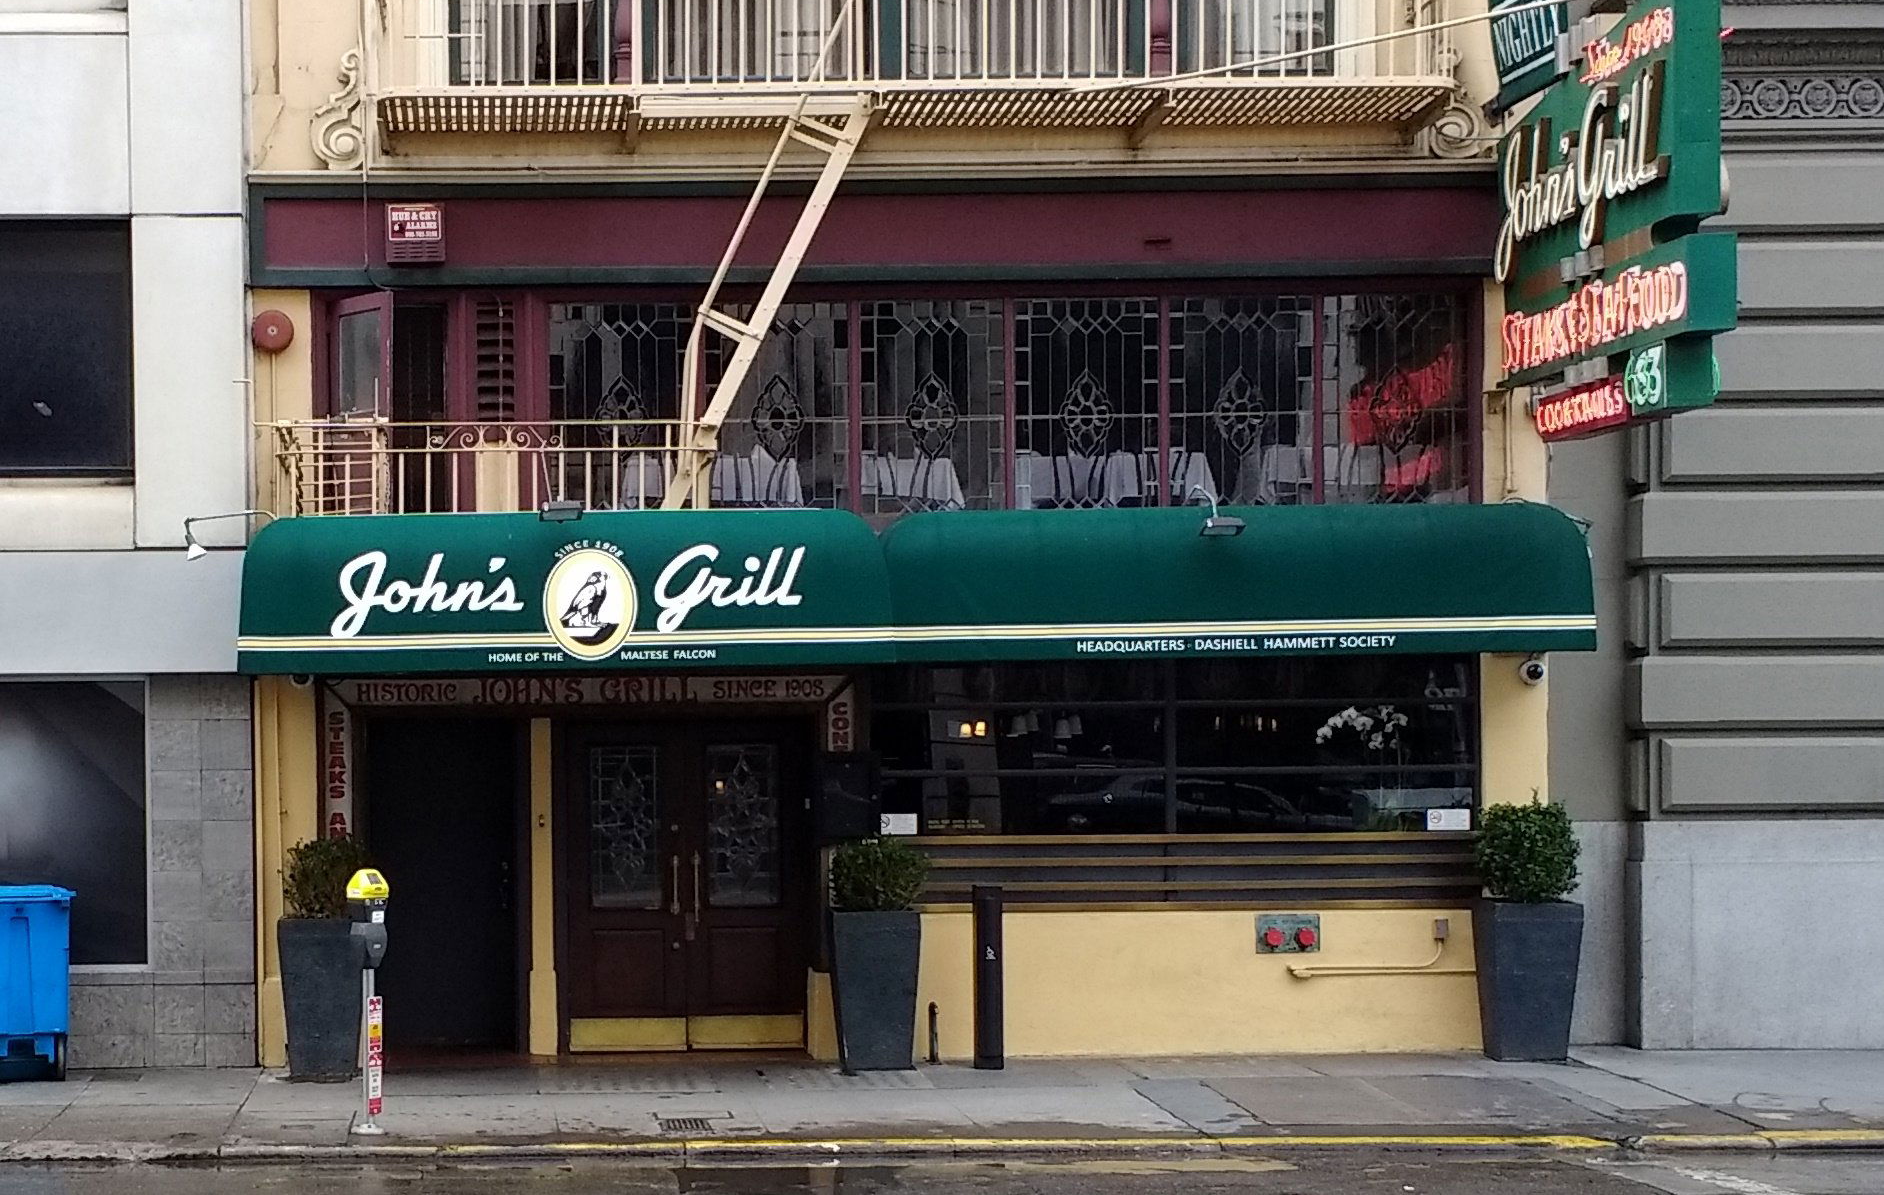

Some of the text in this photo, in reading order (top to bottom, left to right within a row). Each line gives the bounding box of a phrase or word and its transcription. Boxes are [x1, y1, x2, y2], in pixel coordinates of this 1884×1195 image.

[1495, 70, 1664, 284] John's Grill
[554, 539, 624, 559] SINCE 1908
[329, 544, 805, 640] John's Grill
[621, 649, 716, 660] MALTESE FALCON
[1077, 635, 1395, 652] HEADQUARTERS DASHIELL HAMMETT SOCIETY
[488, 652, 564, 662] HOME OF THE
[357, 677, 824, 703] HISTORIC JOHN'S GRILL SINCE 1908
[832, 702, 850, 751] CON
[328, 711, 346, 840] STEAKS AN
